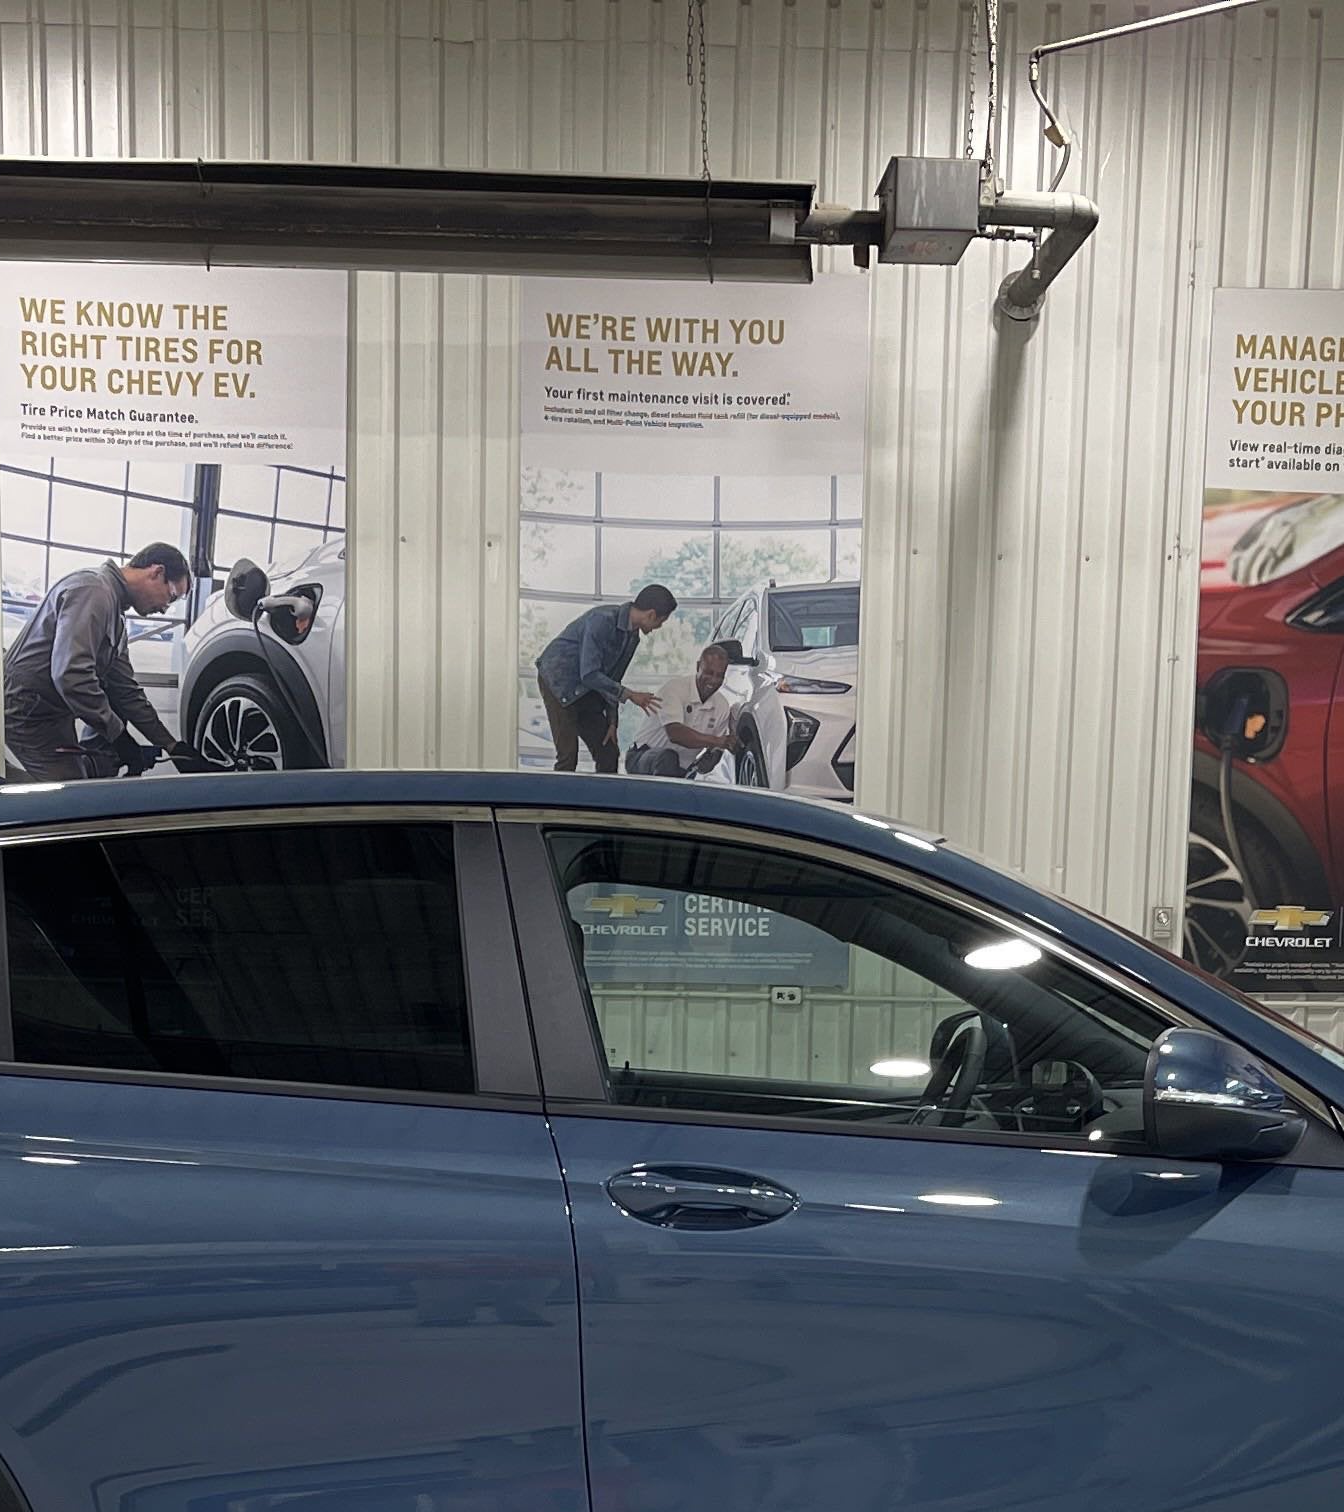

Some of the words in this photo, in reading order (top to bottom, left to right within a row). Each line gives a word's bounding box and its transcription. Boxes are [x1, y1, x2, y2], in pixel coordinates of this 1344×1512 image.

[20, 297, 66, 325] WE
[76, 301, 164, 329] KNOW
[173, 305, 228, 330] THE
[546, 313, 636, 342] WE'RE
[645, 317, 719, 344] WITH
[728, 319, 786, 345] YOU
[21, 331, 107, 360] RIGHT
[117, 335, 199, 363] TIRES
[209, 339, 263, 365] FOR
[544, 346, 599, 373] ALL
[608, 348, 662, 376] THE
[671, 352, 738, 377] WAY.
[20, 364, 97, 393] YOUR
[107, 369, 204, 397] CHEVY
[214, 372, 256, 398] EV.
[544, 386, 573, 400] Your
[577, 388, 604, 401] first
[608, 390, 689, 404] maintenance
[692, 392, 719, 405] visit
[722, 393, 733, 405] is
[20, 403, 46, 416] Tire
[50, 405, 83, 418] Price
[87, 407, 125, 421] Match
[129, 409, 199, 424] Guarantee.
[1231, 399, 1305, 427] YOUR
[1229, 440, 1259, 453] View
[1262, 442, 1321, 455] real-time
[1267, 457, 1322, 472] available
[1324, 461, 1340, 472] on
[581, 924, 668, 936] CHEVROLET
[684, 917, 770, 937] SERVICE
[1245, 936, 1333, 948] CHEVROLET
